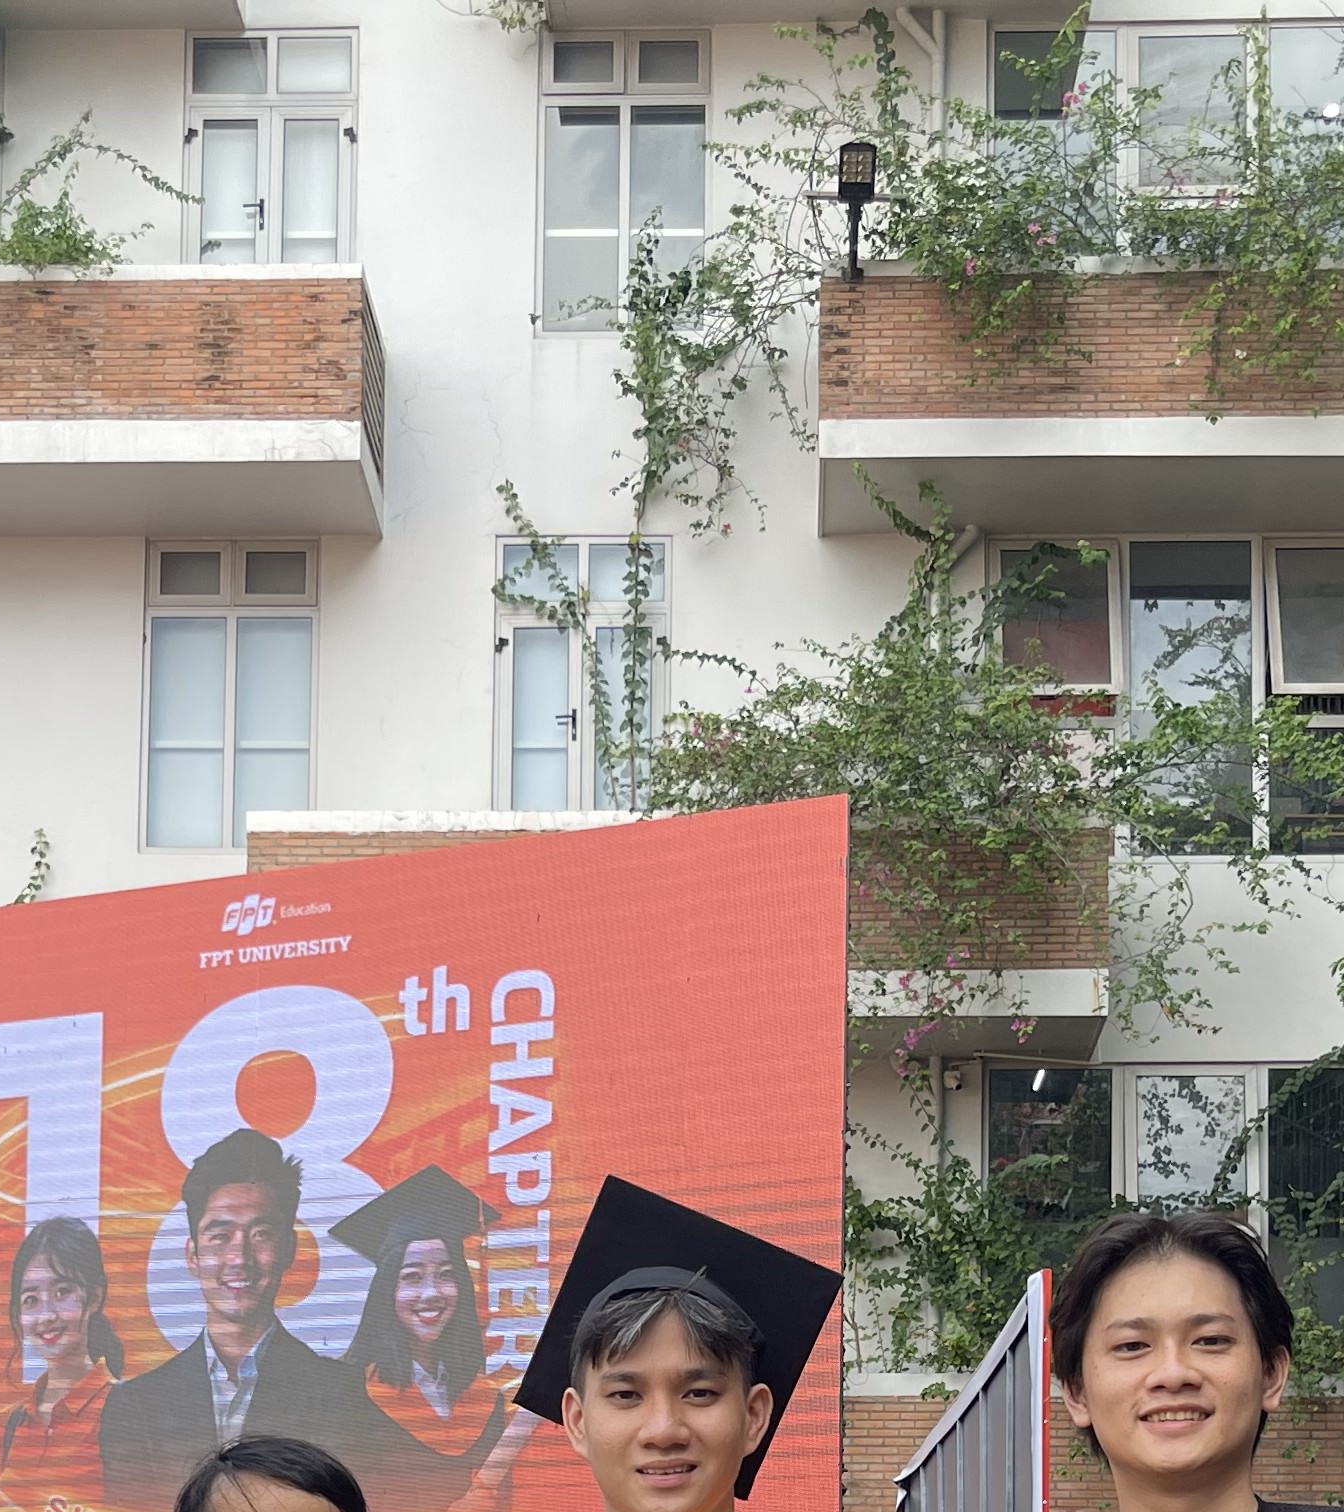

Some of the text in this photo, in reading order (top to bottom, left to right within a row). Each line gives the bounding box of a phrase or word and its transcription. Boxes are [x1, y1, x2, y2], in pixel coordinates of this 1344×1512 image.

[221, 893, 331, 936] FPT Education
[199, 934, 352, 968] FPT UNIVERSITY
[484, 968, 556, 1376] CHAPTER
